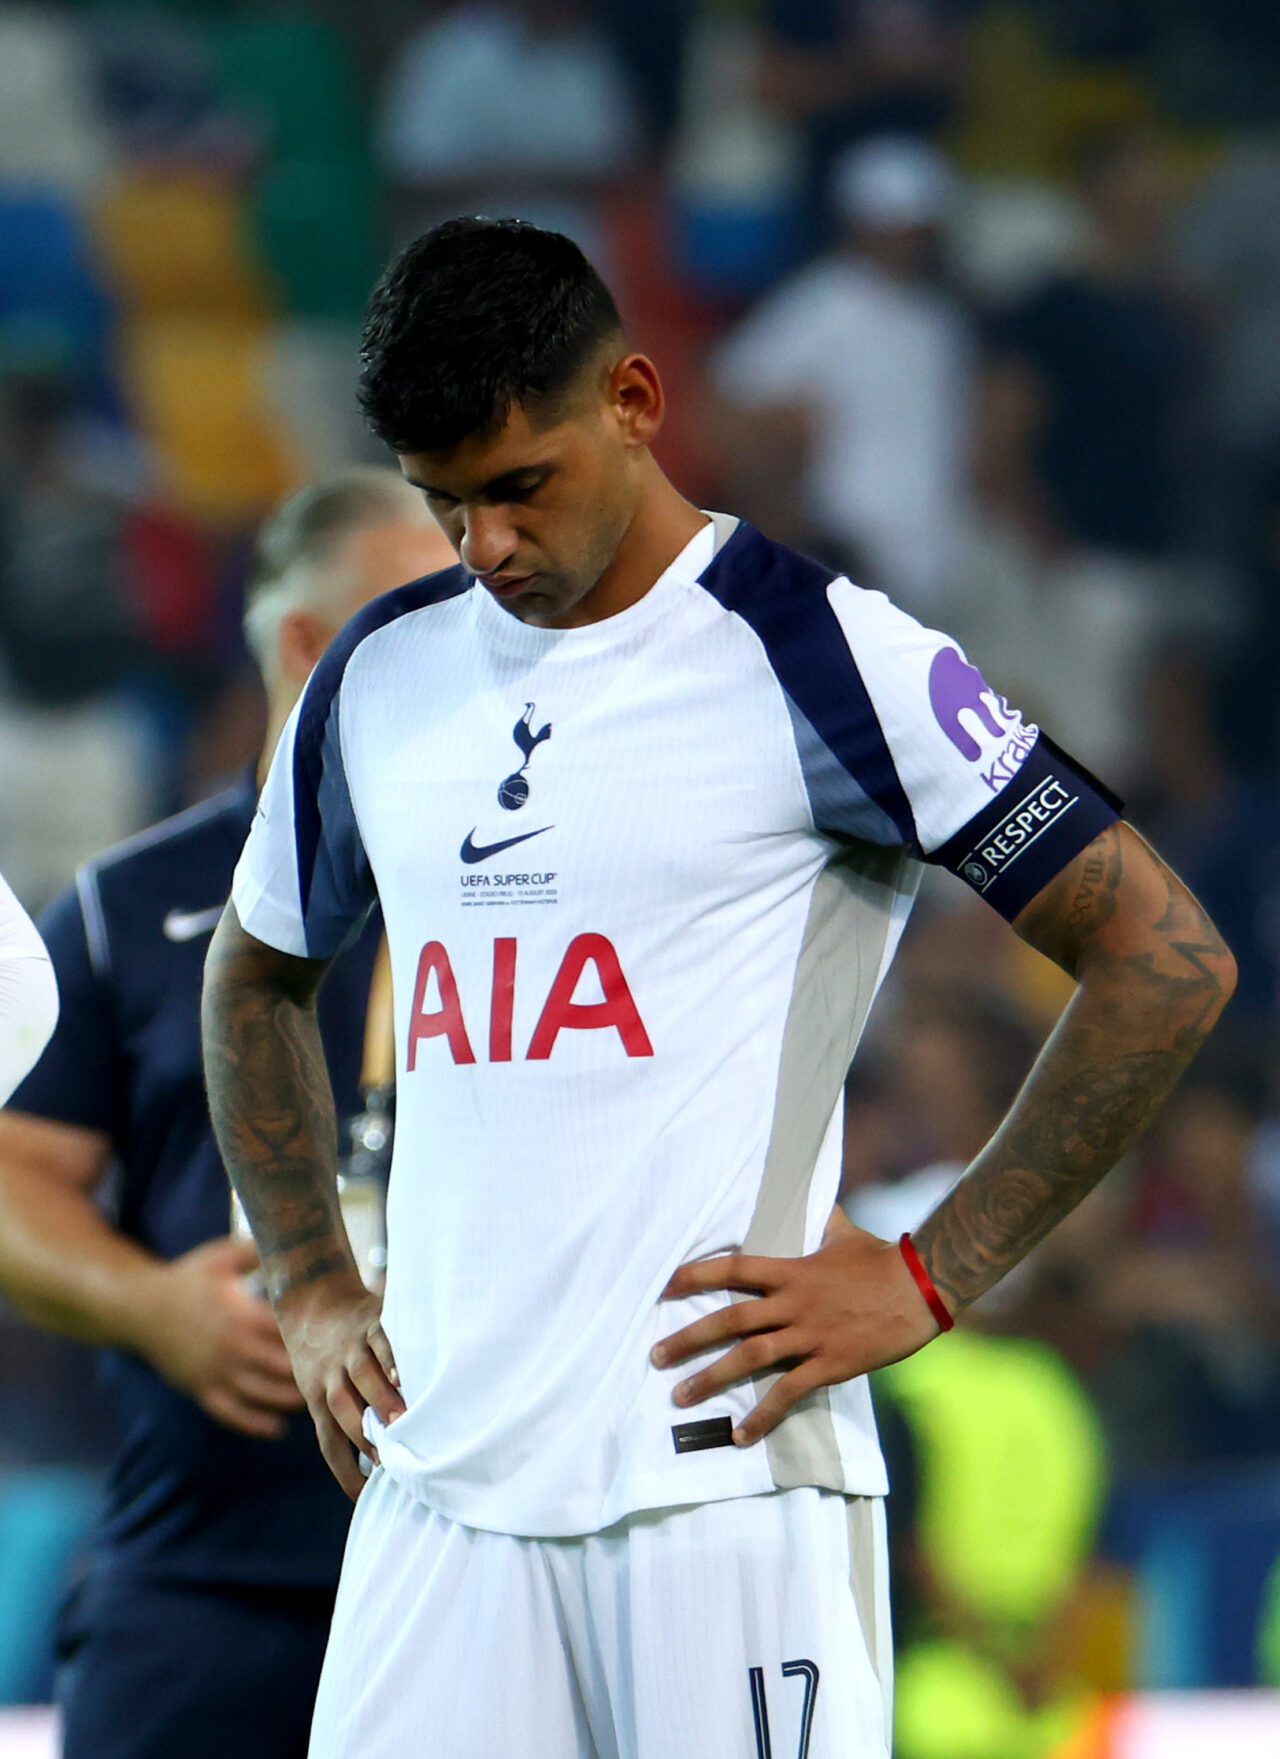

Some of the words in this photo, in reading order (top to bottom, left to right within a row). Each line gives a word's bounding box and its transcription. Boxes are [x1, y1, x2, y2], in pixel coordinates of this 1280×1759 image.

[981, 781, 1070, 867] RESPECT
[460, 875, 491, 887] UEFA
[493, 874, 530, 886] SUPER
[406, 932, 654, 1072] AIA
[748, 1658, 820, 1759] 17
